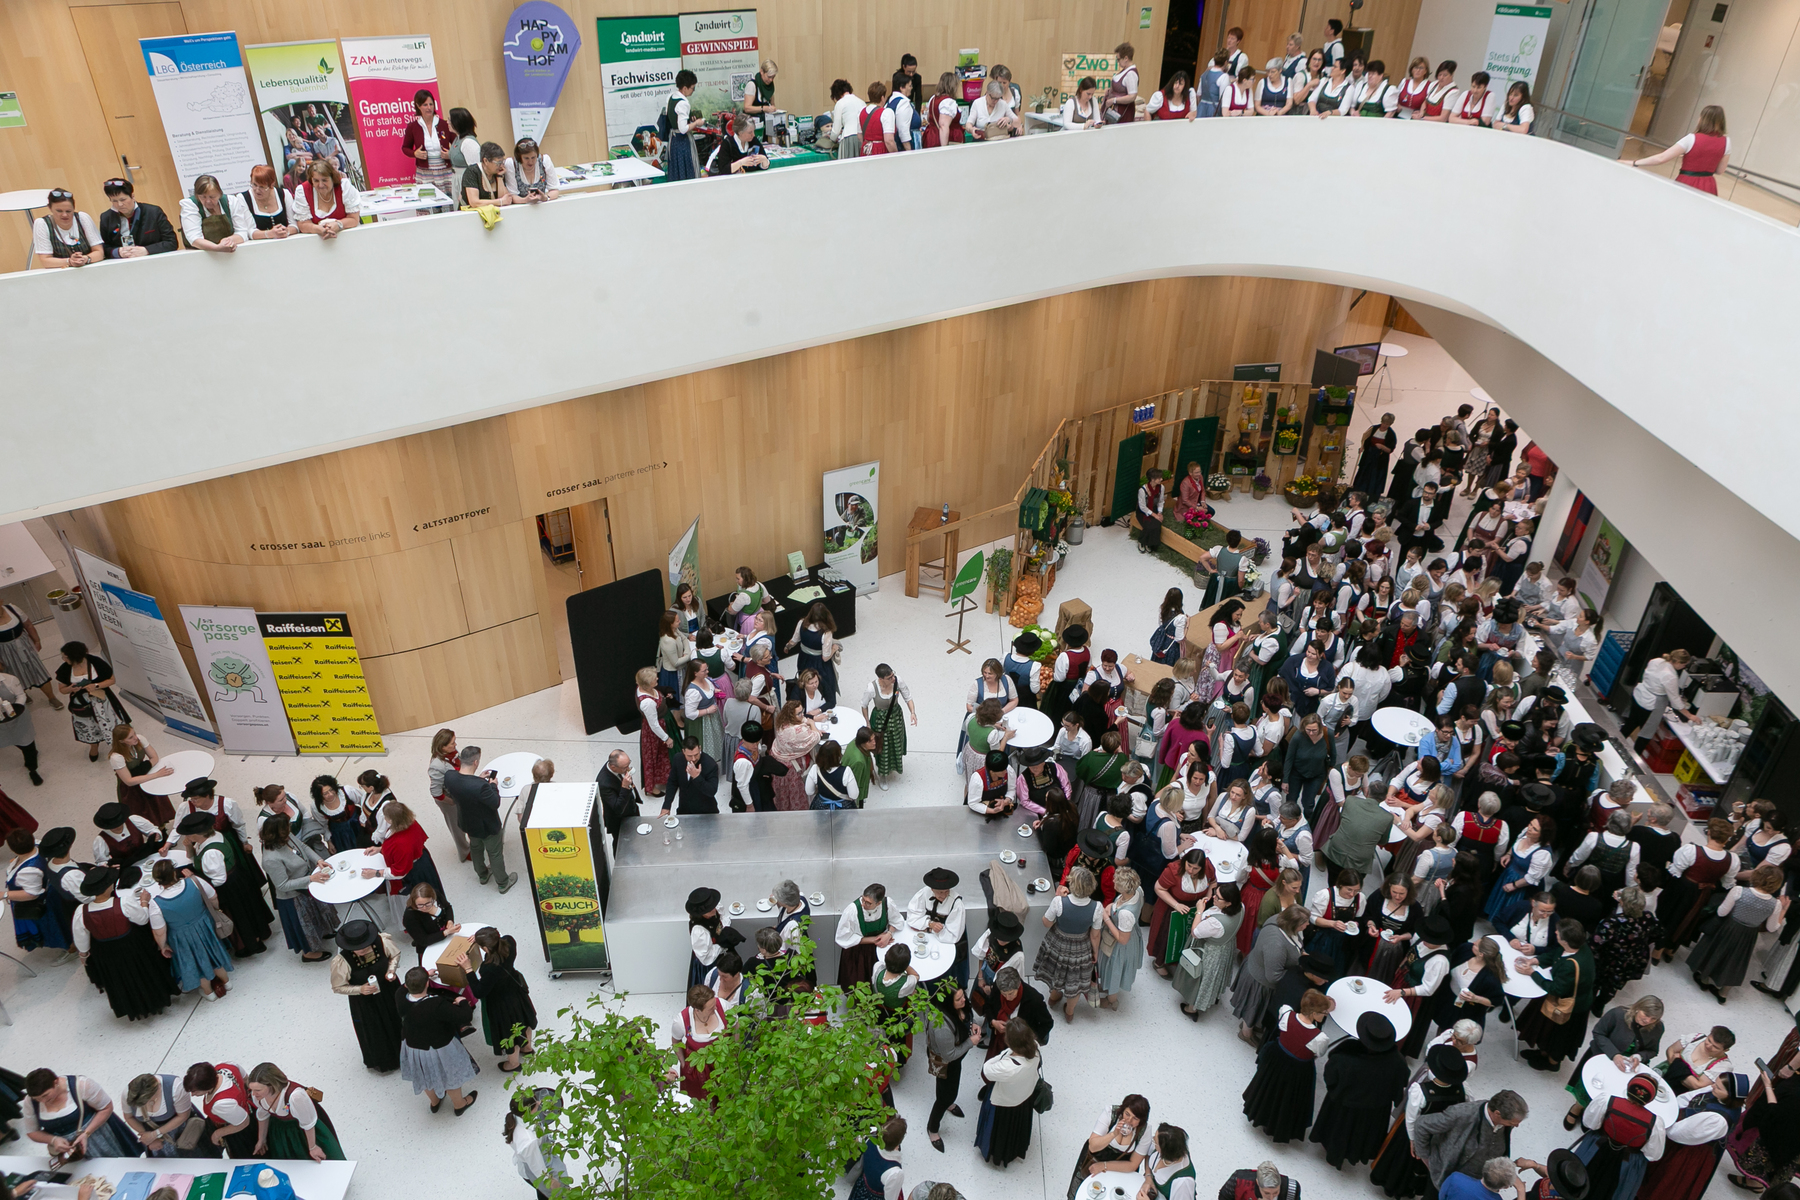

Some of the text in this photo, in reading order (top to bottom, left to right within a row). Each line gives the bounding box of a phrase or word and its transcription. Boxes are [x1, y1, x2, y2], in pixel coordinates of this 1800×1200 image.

[520, 19, 548, 30] HAP
[694, 19, 731, 33] Landwirt
[541, 31, 558, 42] PY
[620, 30, 665, 46] Landwirt
[547, 43, 568, 54] AM
[686, 39, 756, 54] GEWINNSPIEL
[527, 55, 555, 66] HOF
[1488, 51, 1520, 63] Stets in
[155, 60, 227, 74] LBG Österreich
[1486, 62, 1532, 78] Bewegung.
[260, 75, 328, 88] Lebensqualität
[611, 71, 674, 86] Fachwissen
[290, 83, 328, 93] Bauernhof
[631, 90, 643, 98] über
[644, 89, 654, 97] 100
[362, 116, 374, 127] für
[376, 114, 402, 126] starke
[365, 128, 374, 138] in
[375, 128, 389, 138] der
[604, 468, 635, 484] parterre
[636, 462, 661, 474] rechts
[328, 536, 367, 548] parterre
[369, 531, 391, 541] links
[189, 617, 256, 636] Vorsorge
[266, 623, 326, 633] Raiffeisen
[203, 632, 239, 643] pass
[554, 901, 593, 910] RAUCH
